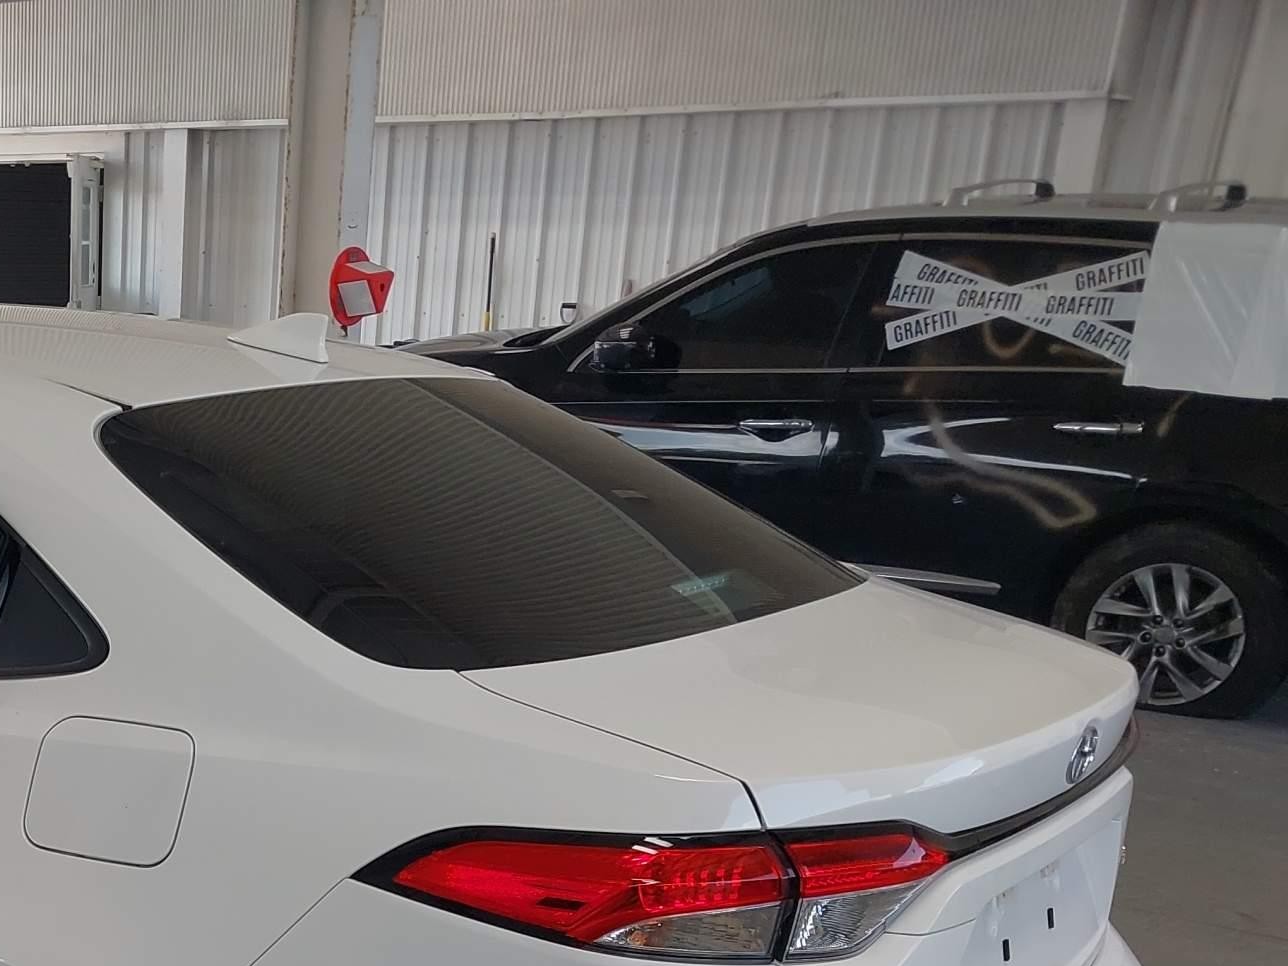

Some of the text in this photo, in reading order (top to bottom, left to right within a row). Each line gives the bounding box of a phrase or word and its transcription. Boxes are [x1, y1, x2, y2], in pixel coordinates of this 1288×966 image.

[917, 263, 979, 286] GRAFFI
[890, 284, 1115, 316] AFFITI GRAFFITI GRAFFITI
[894, 258, 1145, 343] GRAFFITI GRAFFITI
